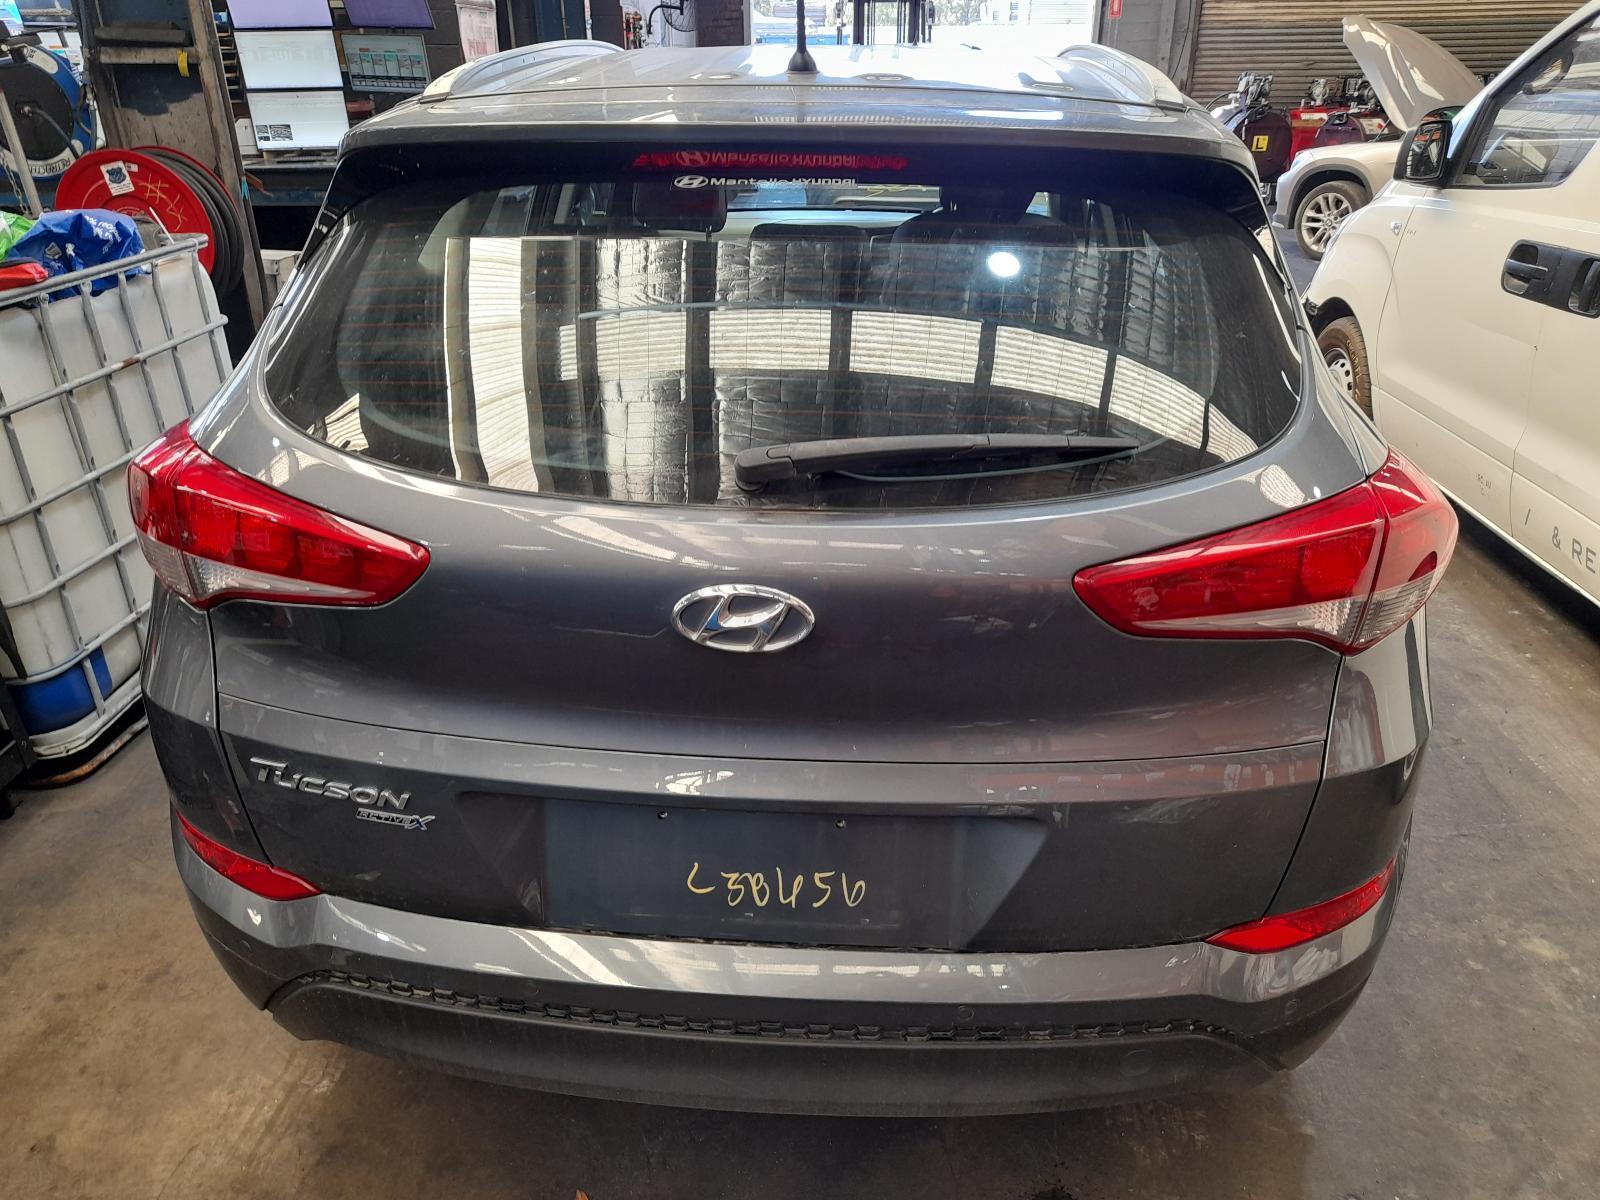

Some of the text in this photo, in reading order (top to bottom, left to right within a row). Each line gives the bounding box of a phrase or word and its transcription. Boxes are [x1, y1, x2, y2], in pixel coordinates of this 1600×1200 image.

[710, 177, 790, 186] Mantello
[1551, 525, 1561, 550] &
[250, 757, 411, 810] TUCSON
